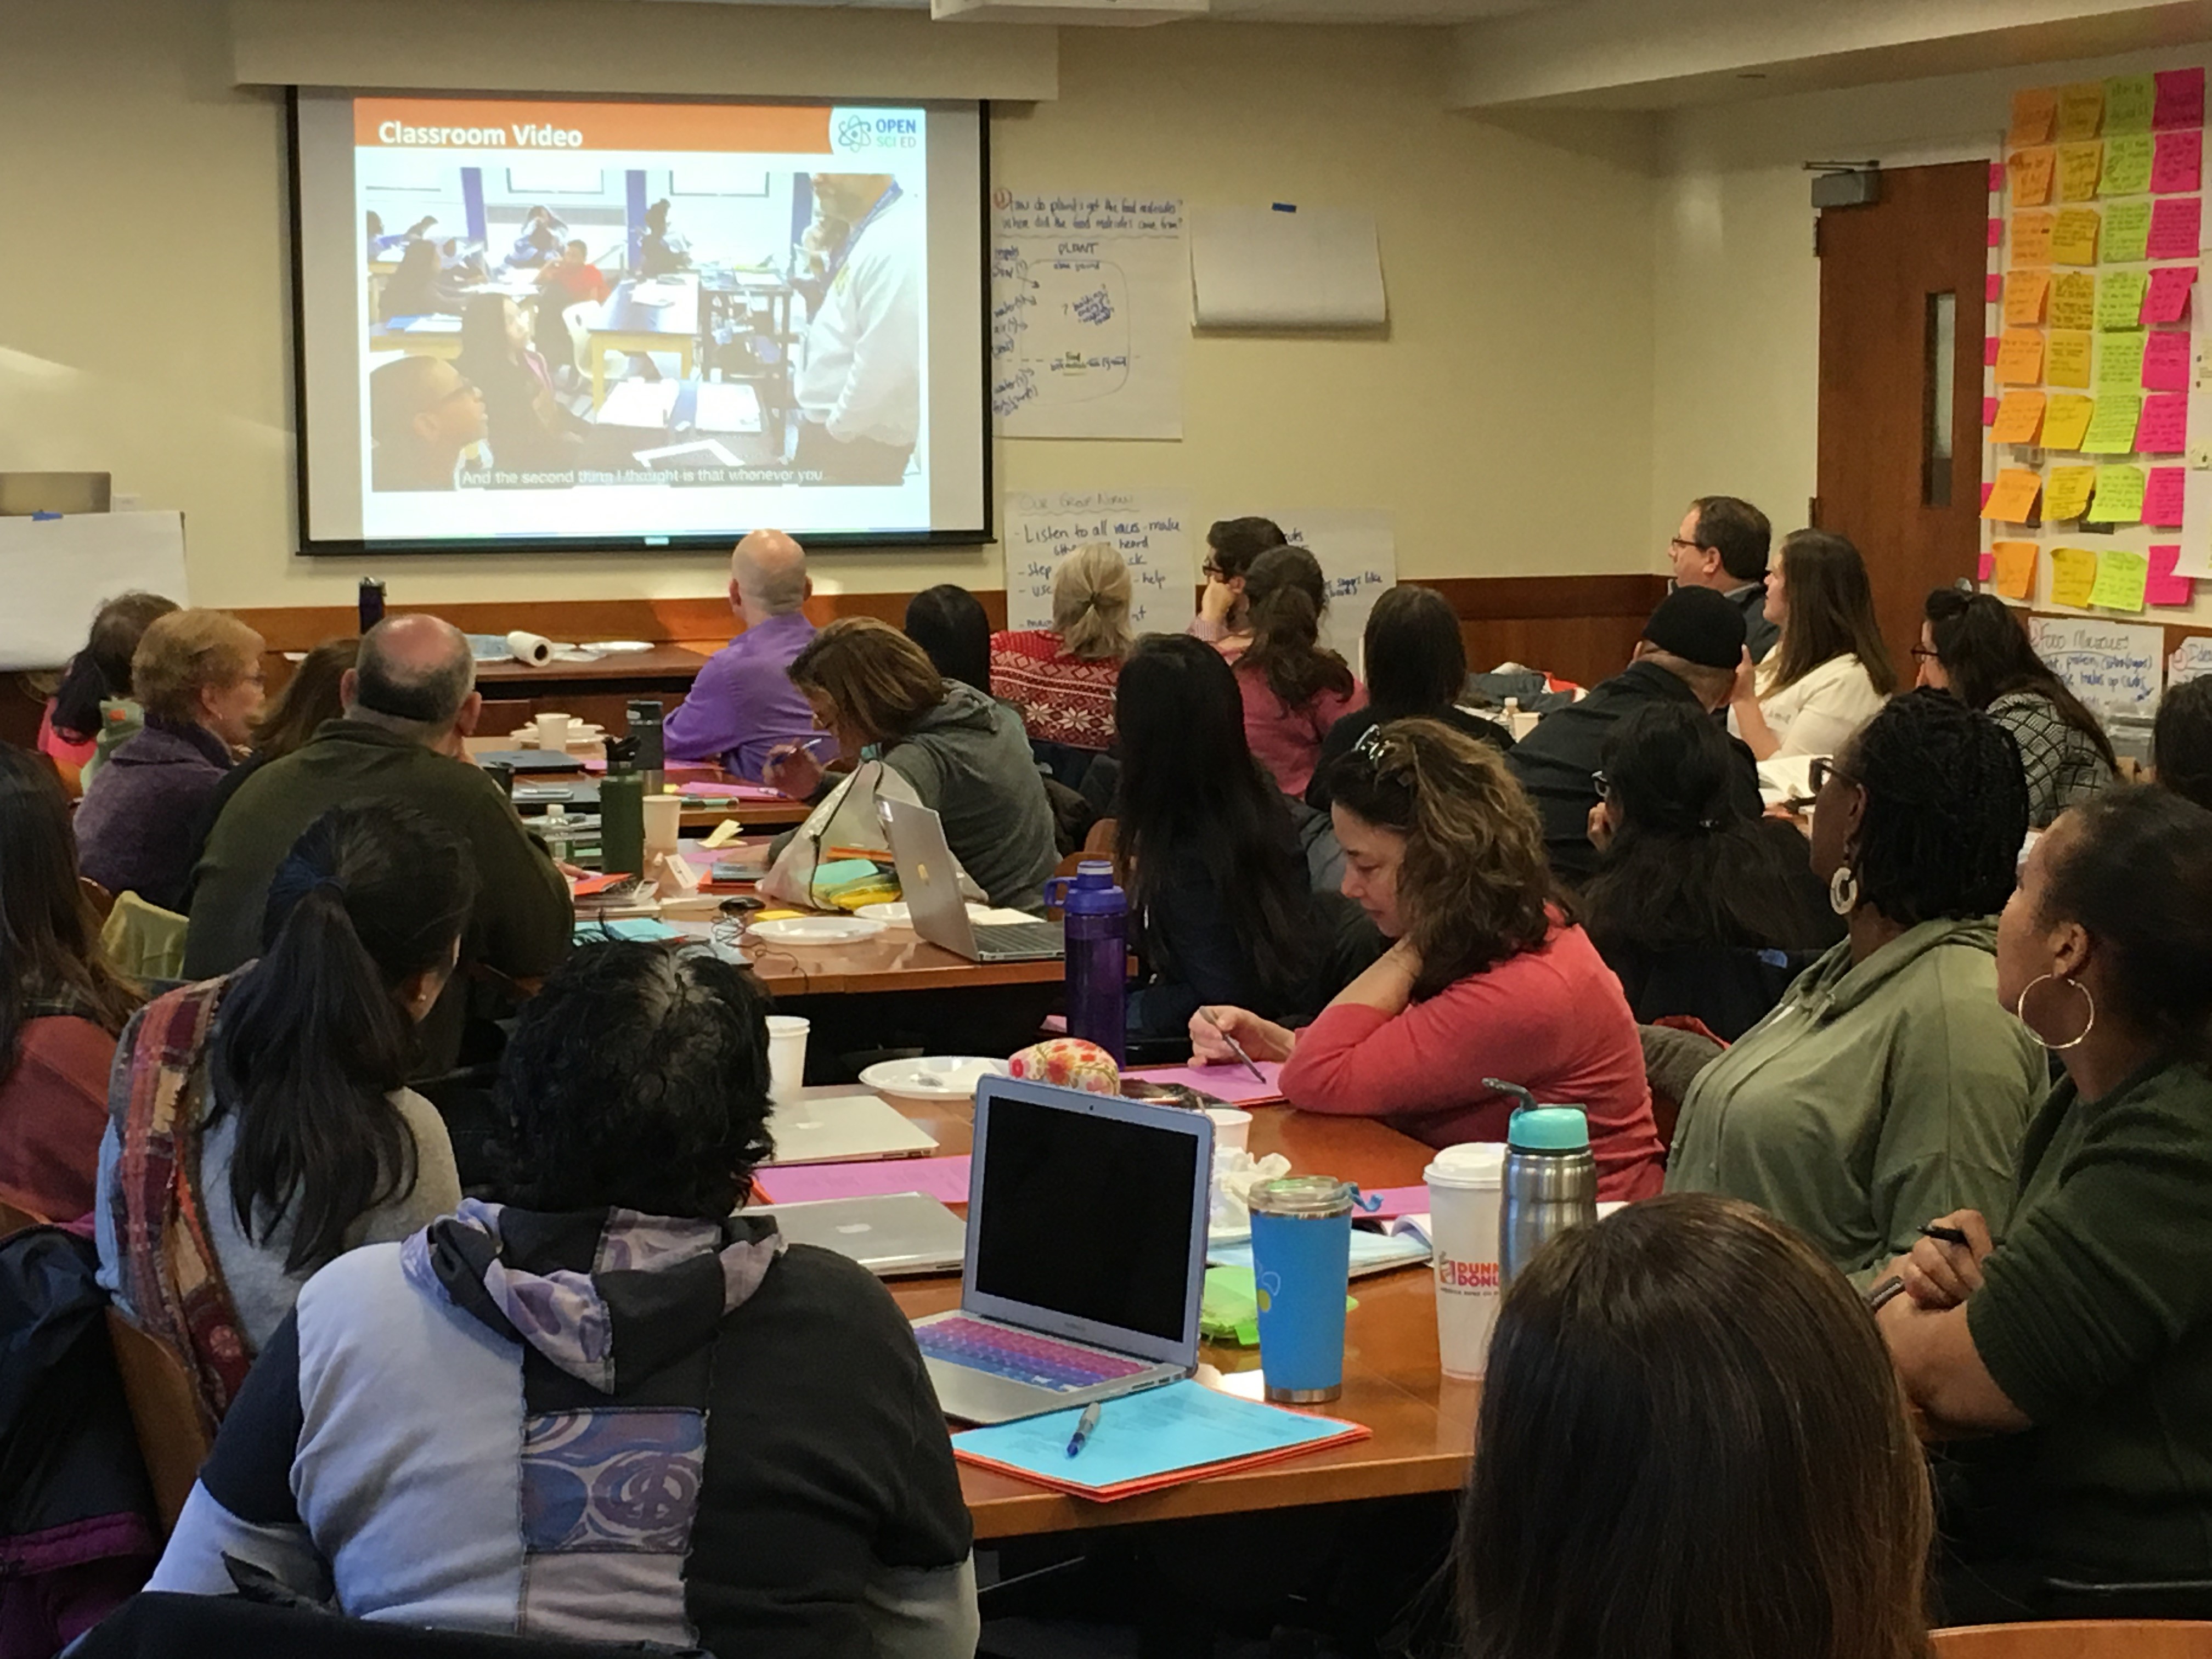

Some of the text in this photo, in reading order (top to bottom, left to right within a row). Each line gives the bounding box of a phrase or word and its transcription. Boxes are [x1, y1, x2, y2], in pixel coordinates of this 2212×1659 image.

[378, 120, 583, 147] Classroom Video
[876, 119, 916, 134] OPEN
[876, 136, 916, 148] SCI ED
[462, 471, 490, 484] And
[495, 471, 518, 484] the
[522, 470, 574, 484] second
[684, 470, 694, 482] is
[697, 469, 725, 482] that
[1024, 524, 1069, 544] Listen
[1074, 523, 1089, 538] to
[1092, 518, 1107, 536] all
